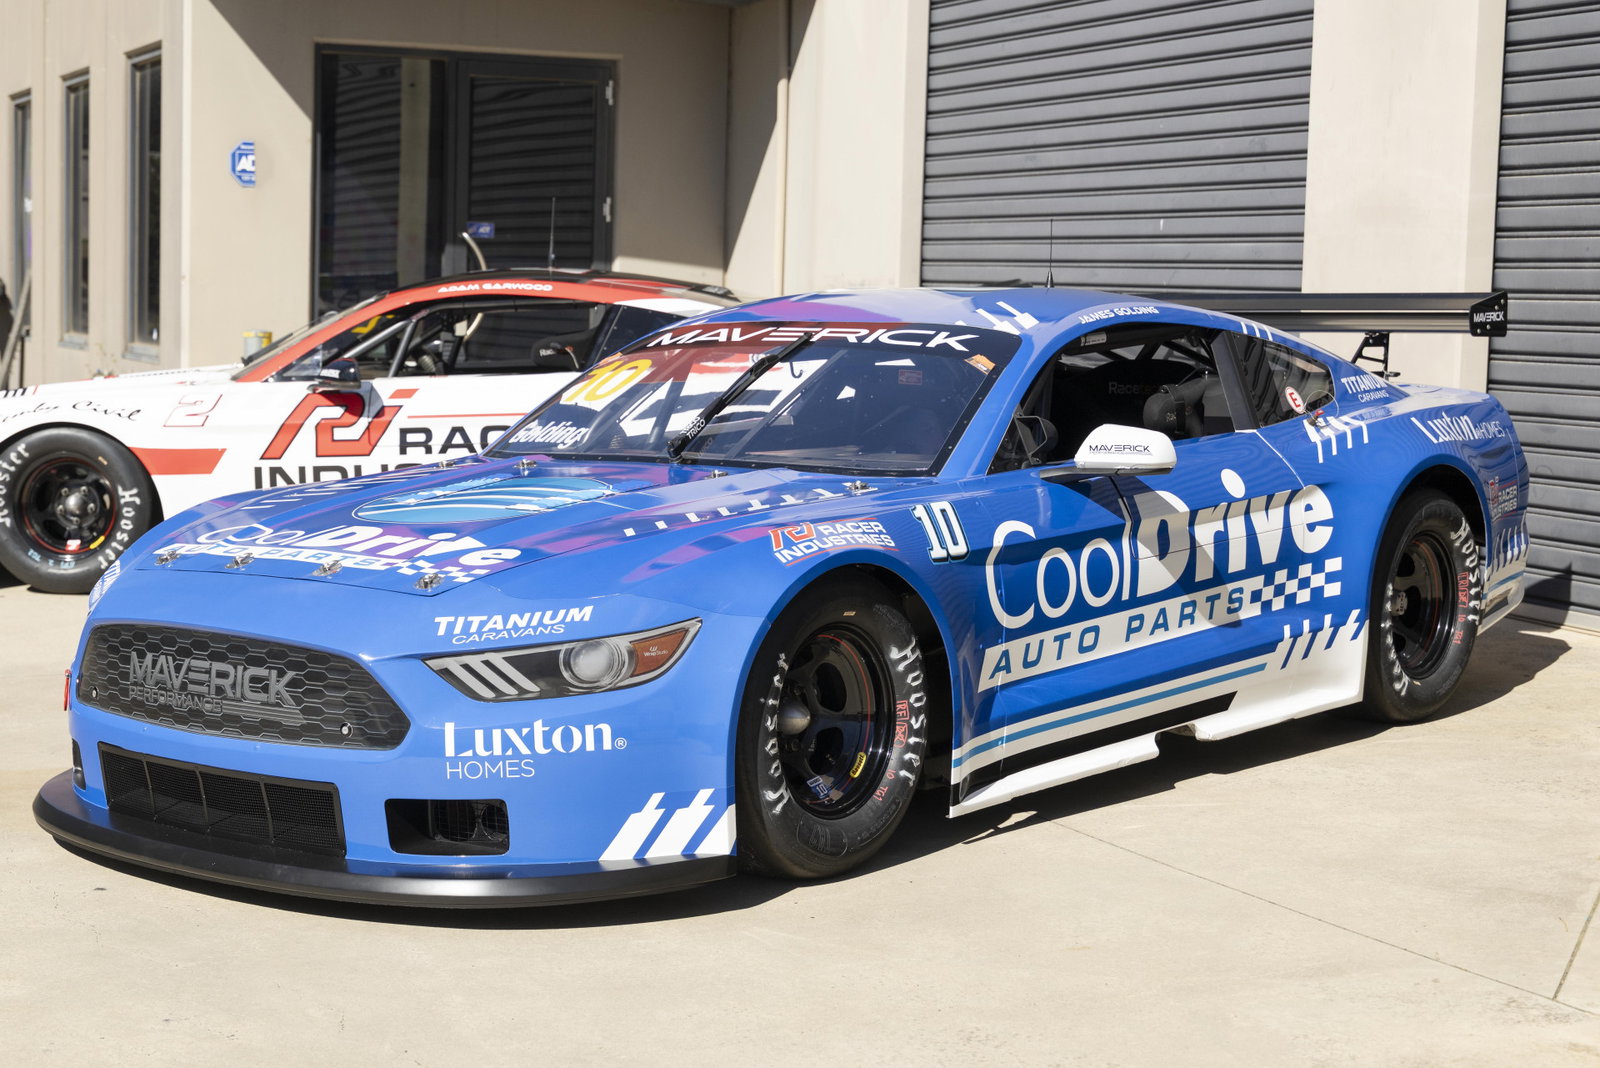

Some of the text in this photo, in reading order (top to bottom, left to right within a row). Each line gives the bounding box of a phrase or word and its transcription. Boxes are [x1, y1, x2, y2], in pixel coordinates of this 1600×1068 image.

[236, 154, 255, 171] AD
[438, 282, 553, 293] ADAM GARWOOD
[1078, 306, 1160, 325] JAMES GOLDING
[1473, 311, 1505, 323] MAVERICK
[646, 327, 980, 352] MAVERICK
[564, 358, 653, 402] 10
[1288, 391, 1301, 408] E
[1357, 389, 1389, 403] CARAVANS
[72, 400, 142, 422] Civil
[685, 418, 706, 440] TRICO
[1479, 421, 1505, 440] HOMES
[1088, 444, 1151, 453] MAVERICK
[816, 521, 887, 536] RACER
[911, 501, 969, 563] 10
[261, 549, 382, 567] PARTS
[774, 534, 896, 564] INDUSTRIES
[434, 605, 594, 636] TITANIUM
[451, 624, 566, 645] CARAVANS
[989, 586, 1245, 680] AUTO PARTS
[129, 651, 297, 707] MAVERICK
[129, 685, 223, 714] PERFORMANCE
[446, 759, 535, 780] HOMES
